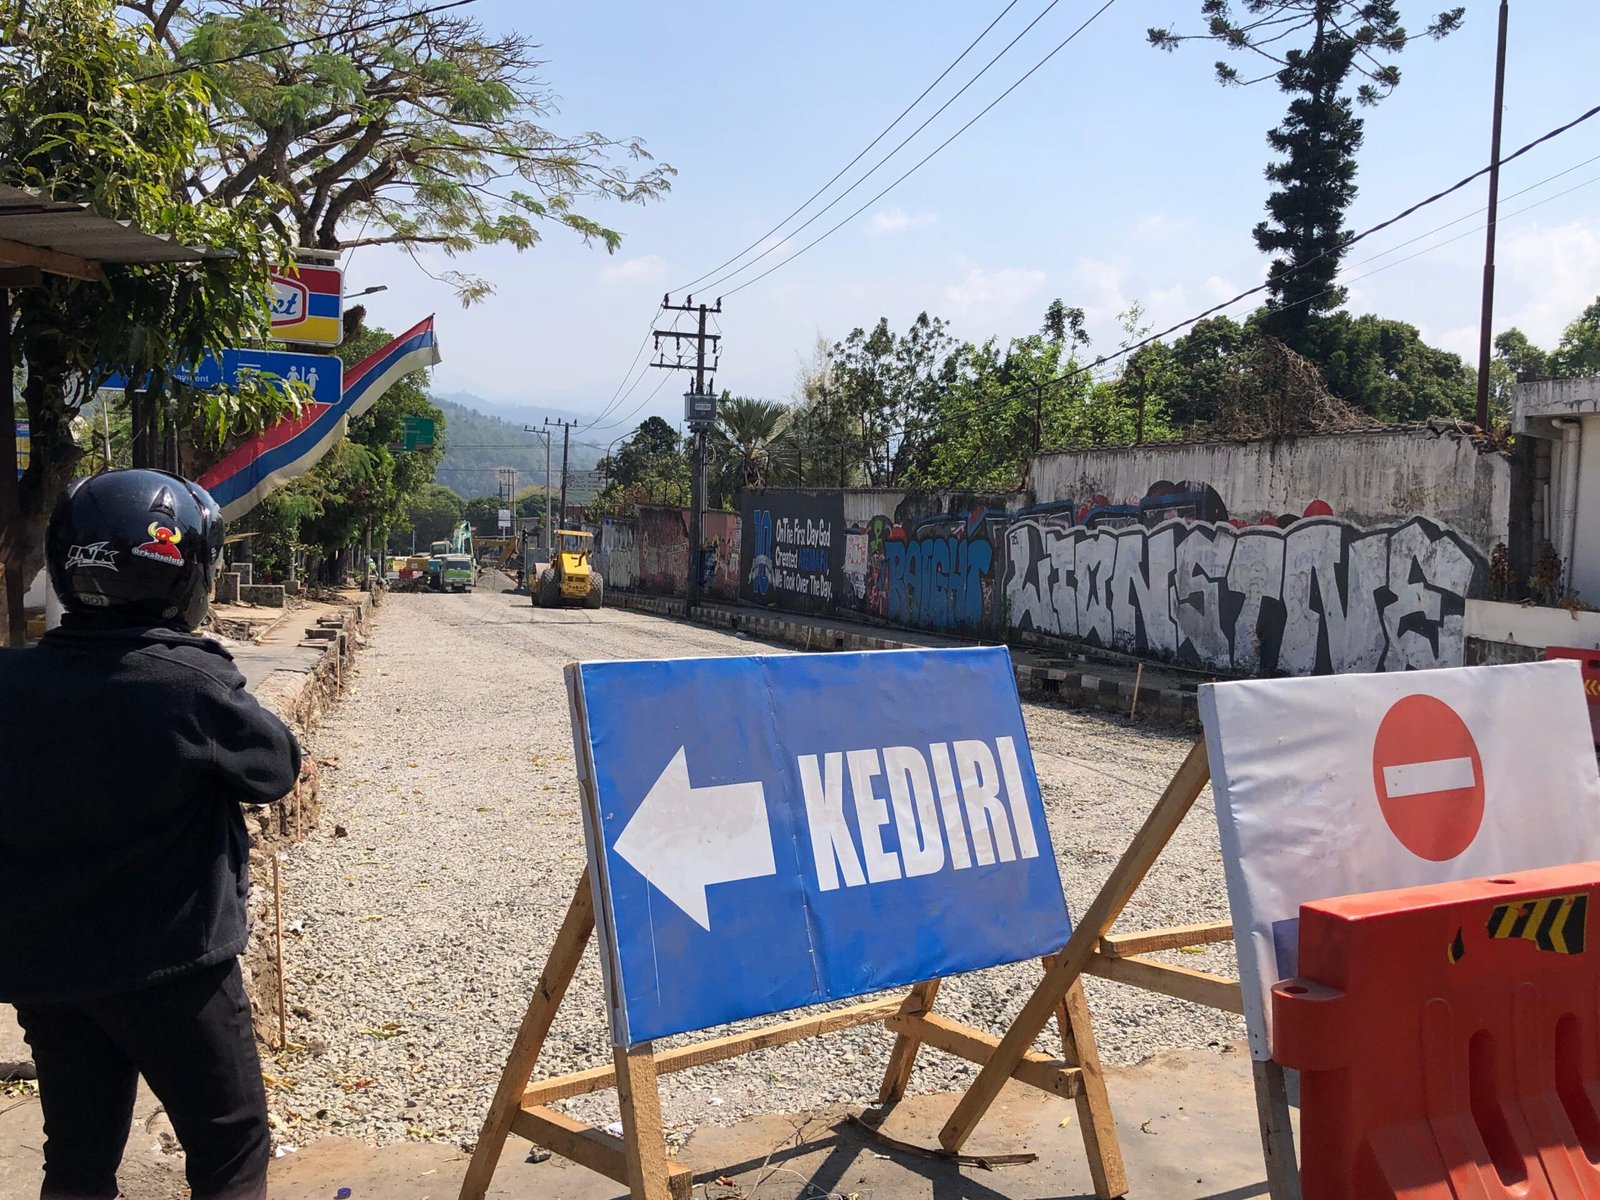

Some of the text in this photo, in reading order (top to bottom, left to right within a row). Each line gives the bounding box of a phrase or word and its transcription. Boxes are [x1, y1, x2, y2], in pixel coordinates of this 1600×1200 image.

[776, 518, 831, 548] On The First Day God
[66, 542, 120, 568] INK
[775, 546, 798, 568] Created
[775, 569, 782, 589] We
[783, 571, 796, 590] Took
[796, 573, 809, 593] Over
[810, 575, 820, 596] The
[797, 736, 1039, 892] KEDIRI
